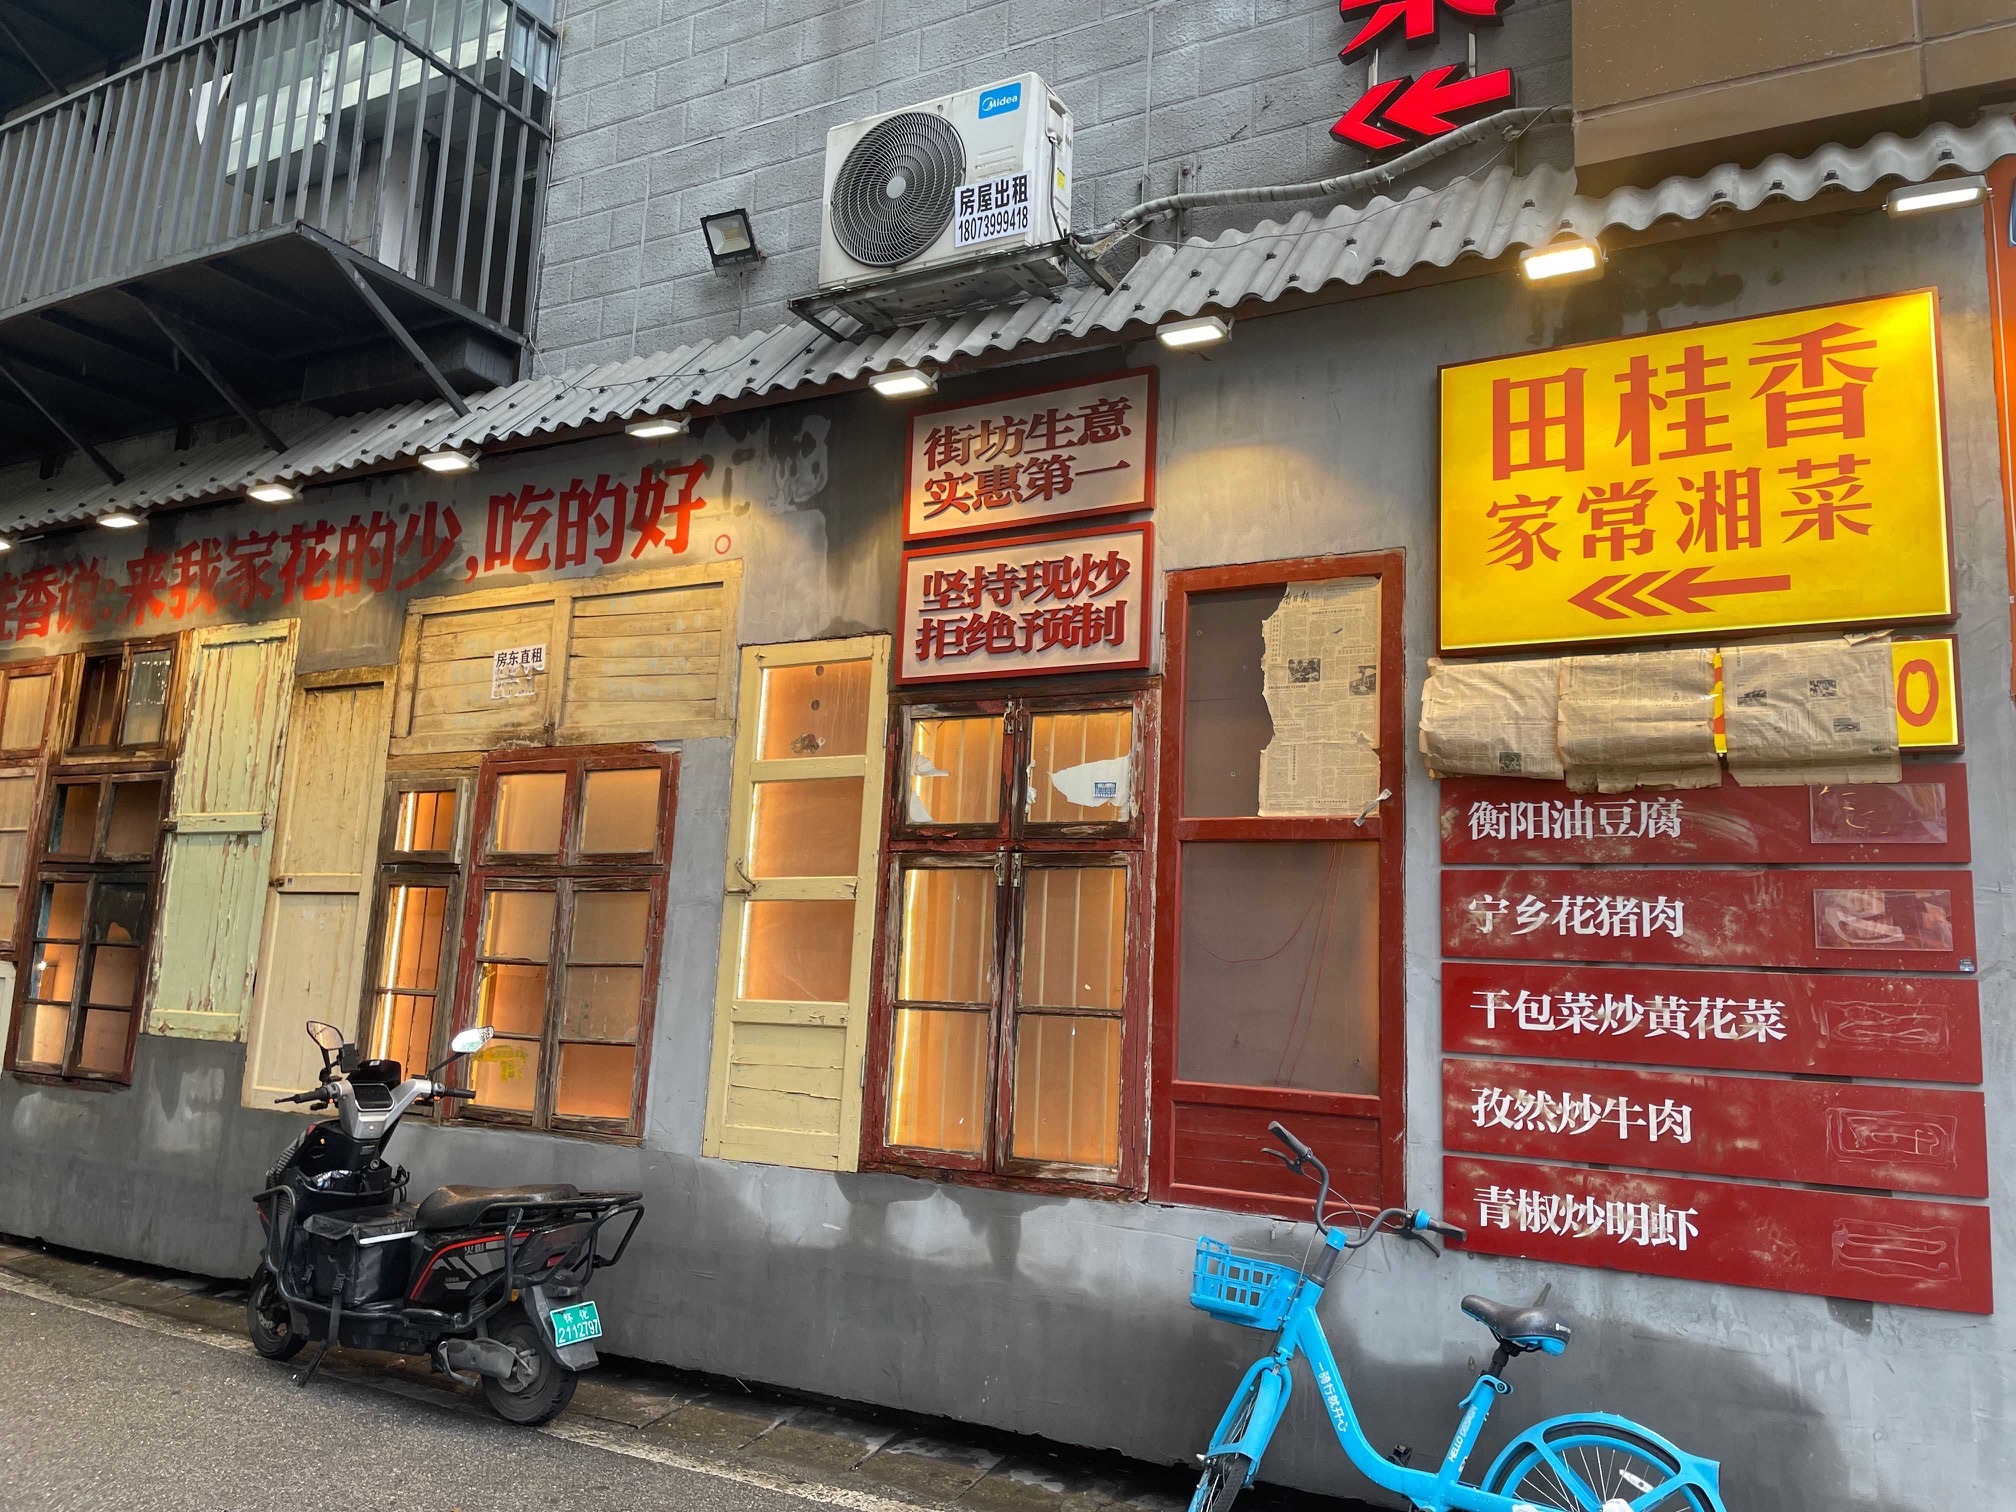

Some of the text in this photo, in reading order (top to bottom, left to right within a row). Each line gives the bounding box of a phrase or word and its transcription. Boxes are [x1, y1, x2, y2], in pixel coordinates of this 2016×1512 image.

[982, 95, 1018, 111] Midea
[959, 174, 1028, 217] 房屋出租
[958, 206, 1028, 242] 18073999418
[1492, 322, 1879, 481] 田桂香
[924, 397, 1132, 471] 街坊生意
[924, 454, 1131, 520] 实惠第一
[1486, 454, 1873, 571] 家常湘菜
[919, 551, 1130, 612] 坚持现炒
[915, 600, 1127, 661] 拒绝预制
[496, 648, 542, 668] 房东直租
[1468, 797, 1684, 840] 衡阳油豆腐
[1468, 894, 1685, 938] 宁乡花猪肉
[1470, 989, 1788, 1043] 干包菜炒黄花菜
[1471, 1087, 1693, 1144] 孜然炒牛肉
[1473, 1185, 1699, 1251] 青椒炒明虾
[558, 1318, 599, 1343] 2112797
[1448, 1436, 1464, 1462] HELLO
